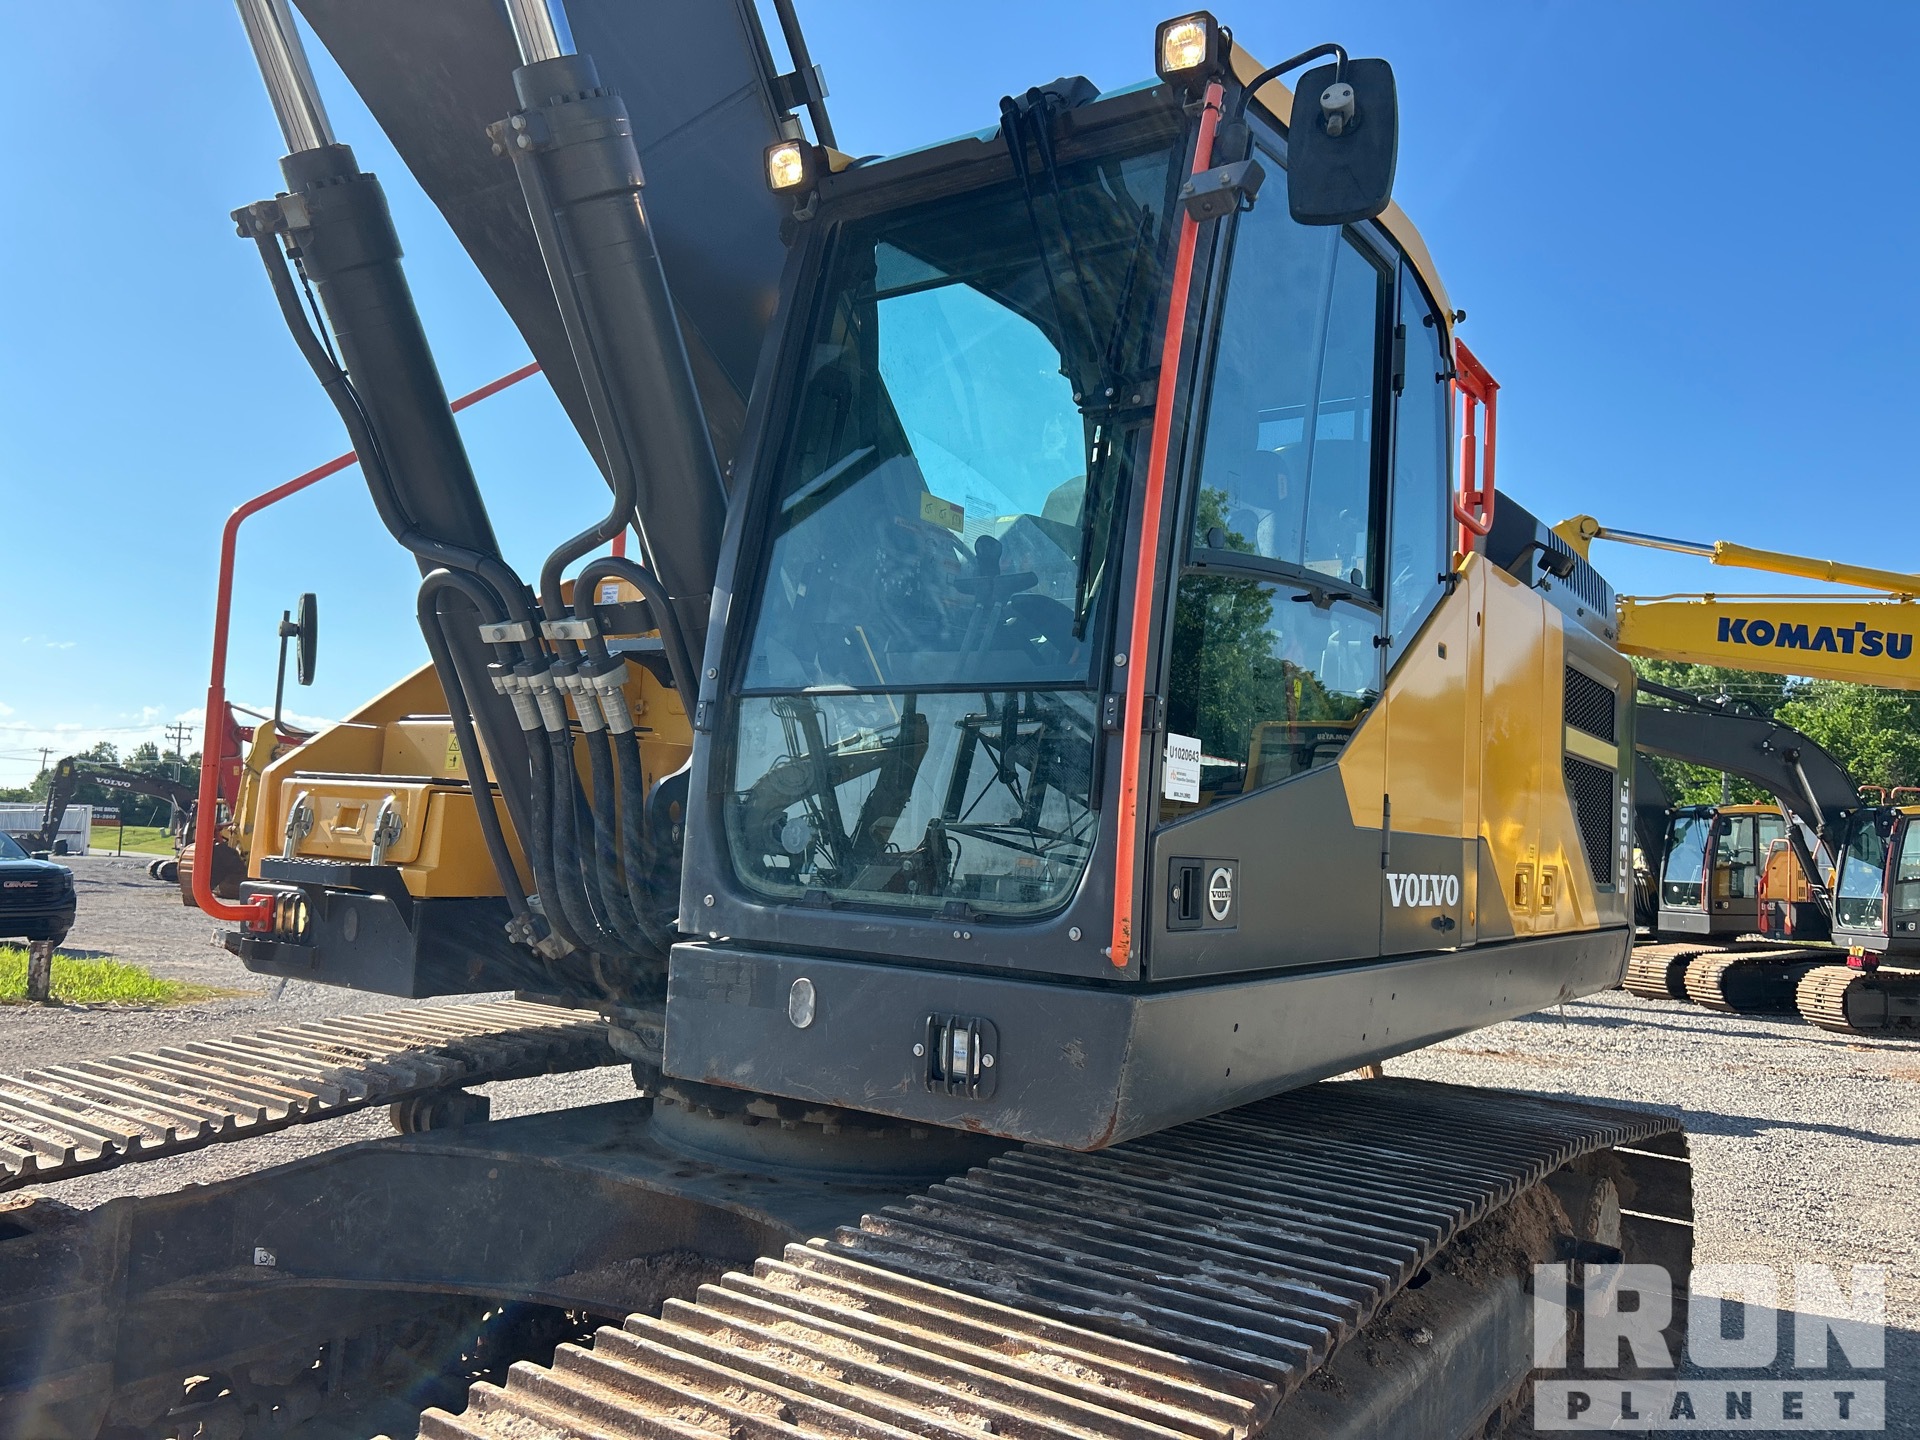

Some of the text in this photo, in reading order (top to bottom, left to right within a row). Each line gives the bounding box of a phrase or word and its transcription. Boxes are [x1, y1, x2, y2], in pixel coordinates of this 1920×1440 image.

[1717, 616, 1913, 660] KOMATSU
[1169, 745, 1200, 763] U1020643
[95, 777, 131, 788] VOLVO
[3, 880, 39, 888] GMC
[1386, 873, 1459, 908] VOLVO
